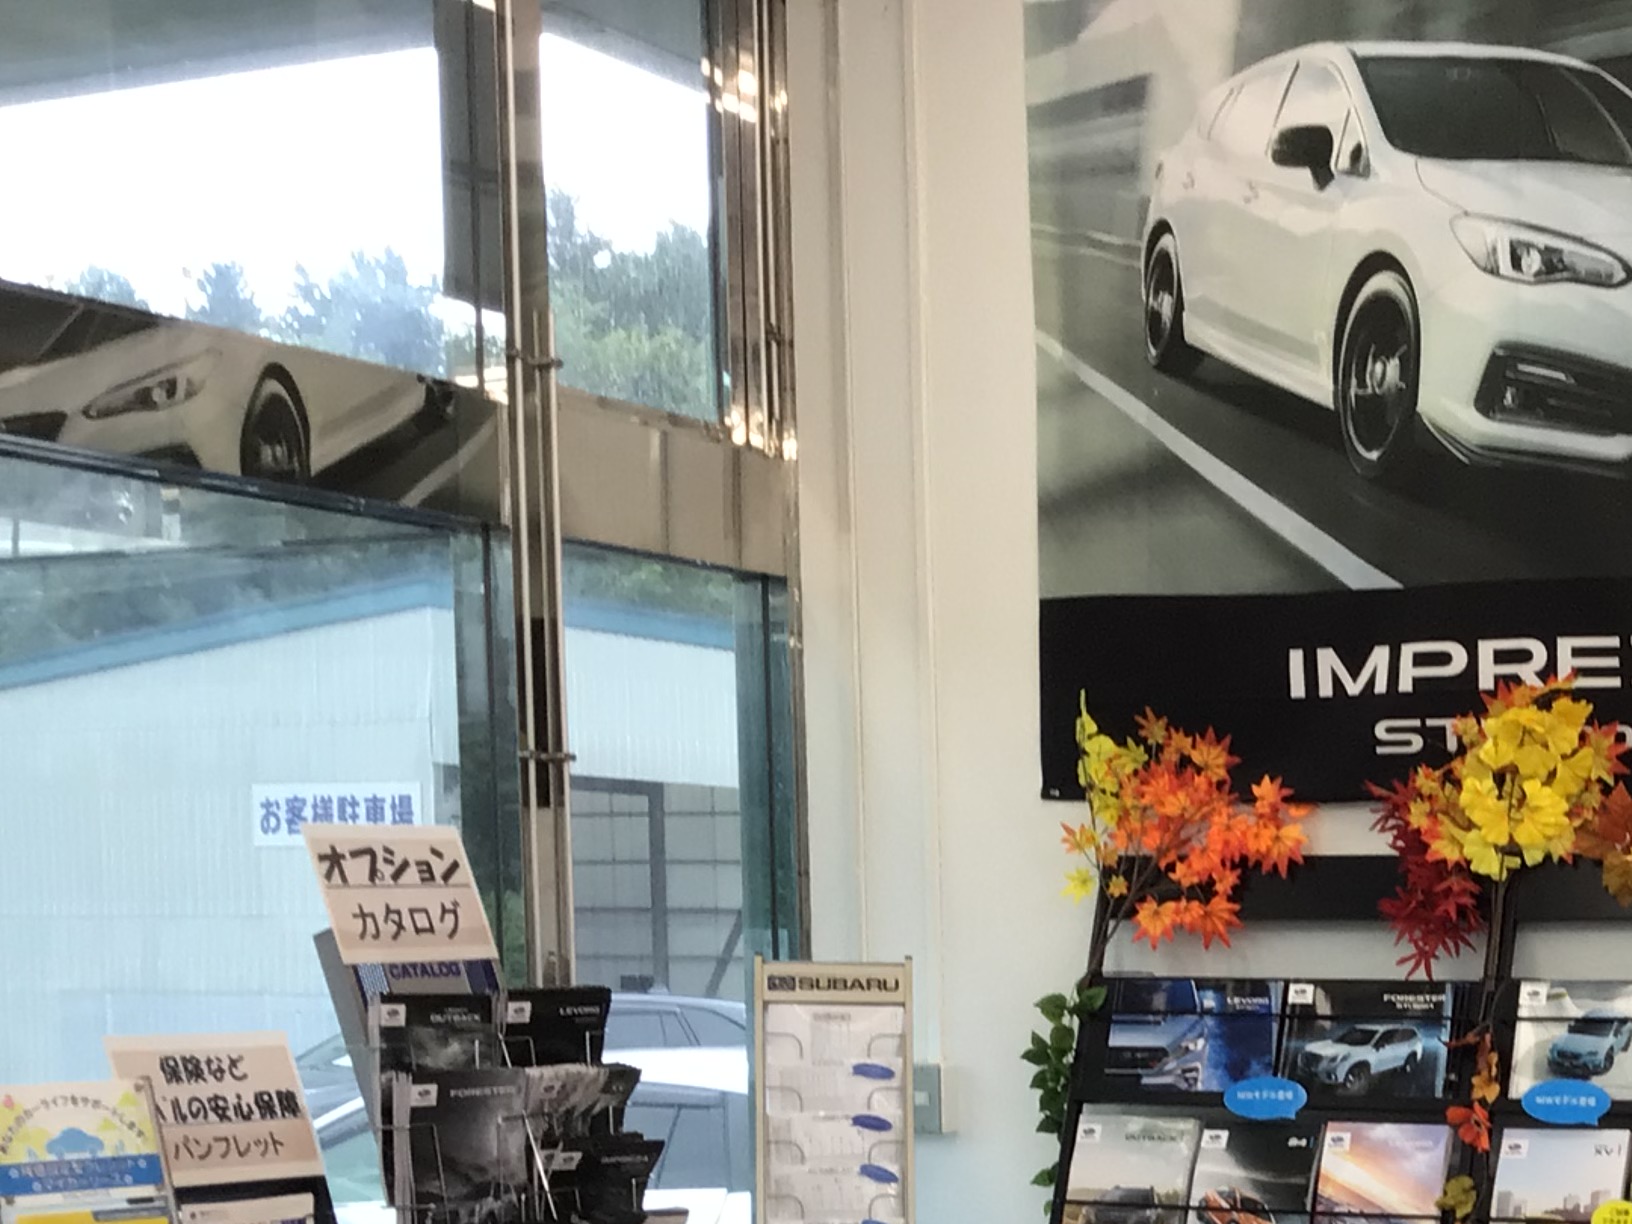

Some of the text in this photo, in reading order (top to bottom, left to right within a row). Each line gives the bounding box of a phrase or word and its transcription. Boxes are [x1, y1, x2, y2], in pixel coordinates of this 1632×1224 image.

[260, 794, 414, 835] お客様駐車場
[318, 845, 460, 884] オプション
[352, 898, 460, 941] カタログ
[389, 962, 461, 979] CATALOG
[798, 976, 900, 992] SUBARU
[160, 1054, 248, 1085] 保険など
[174, 1131, 284, 1160] パンフレット
